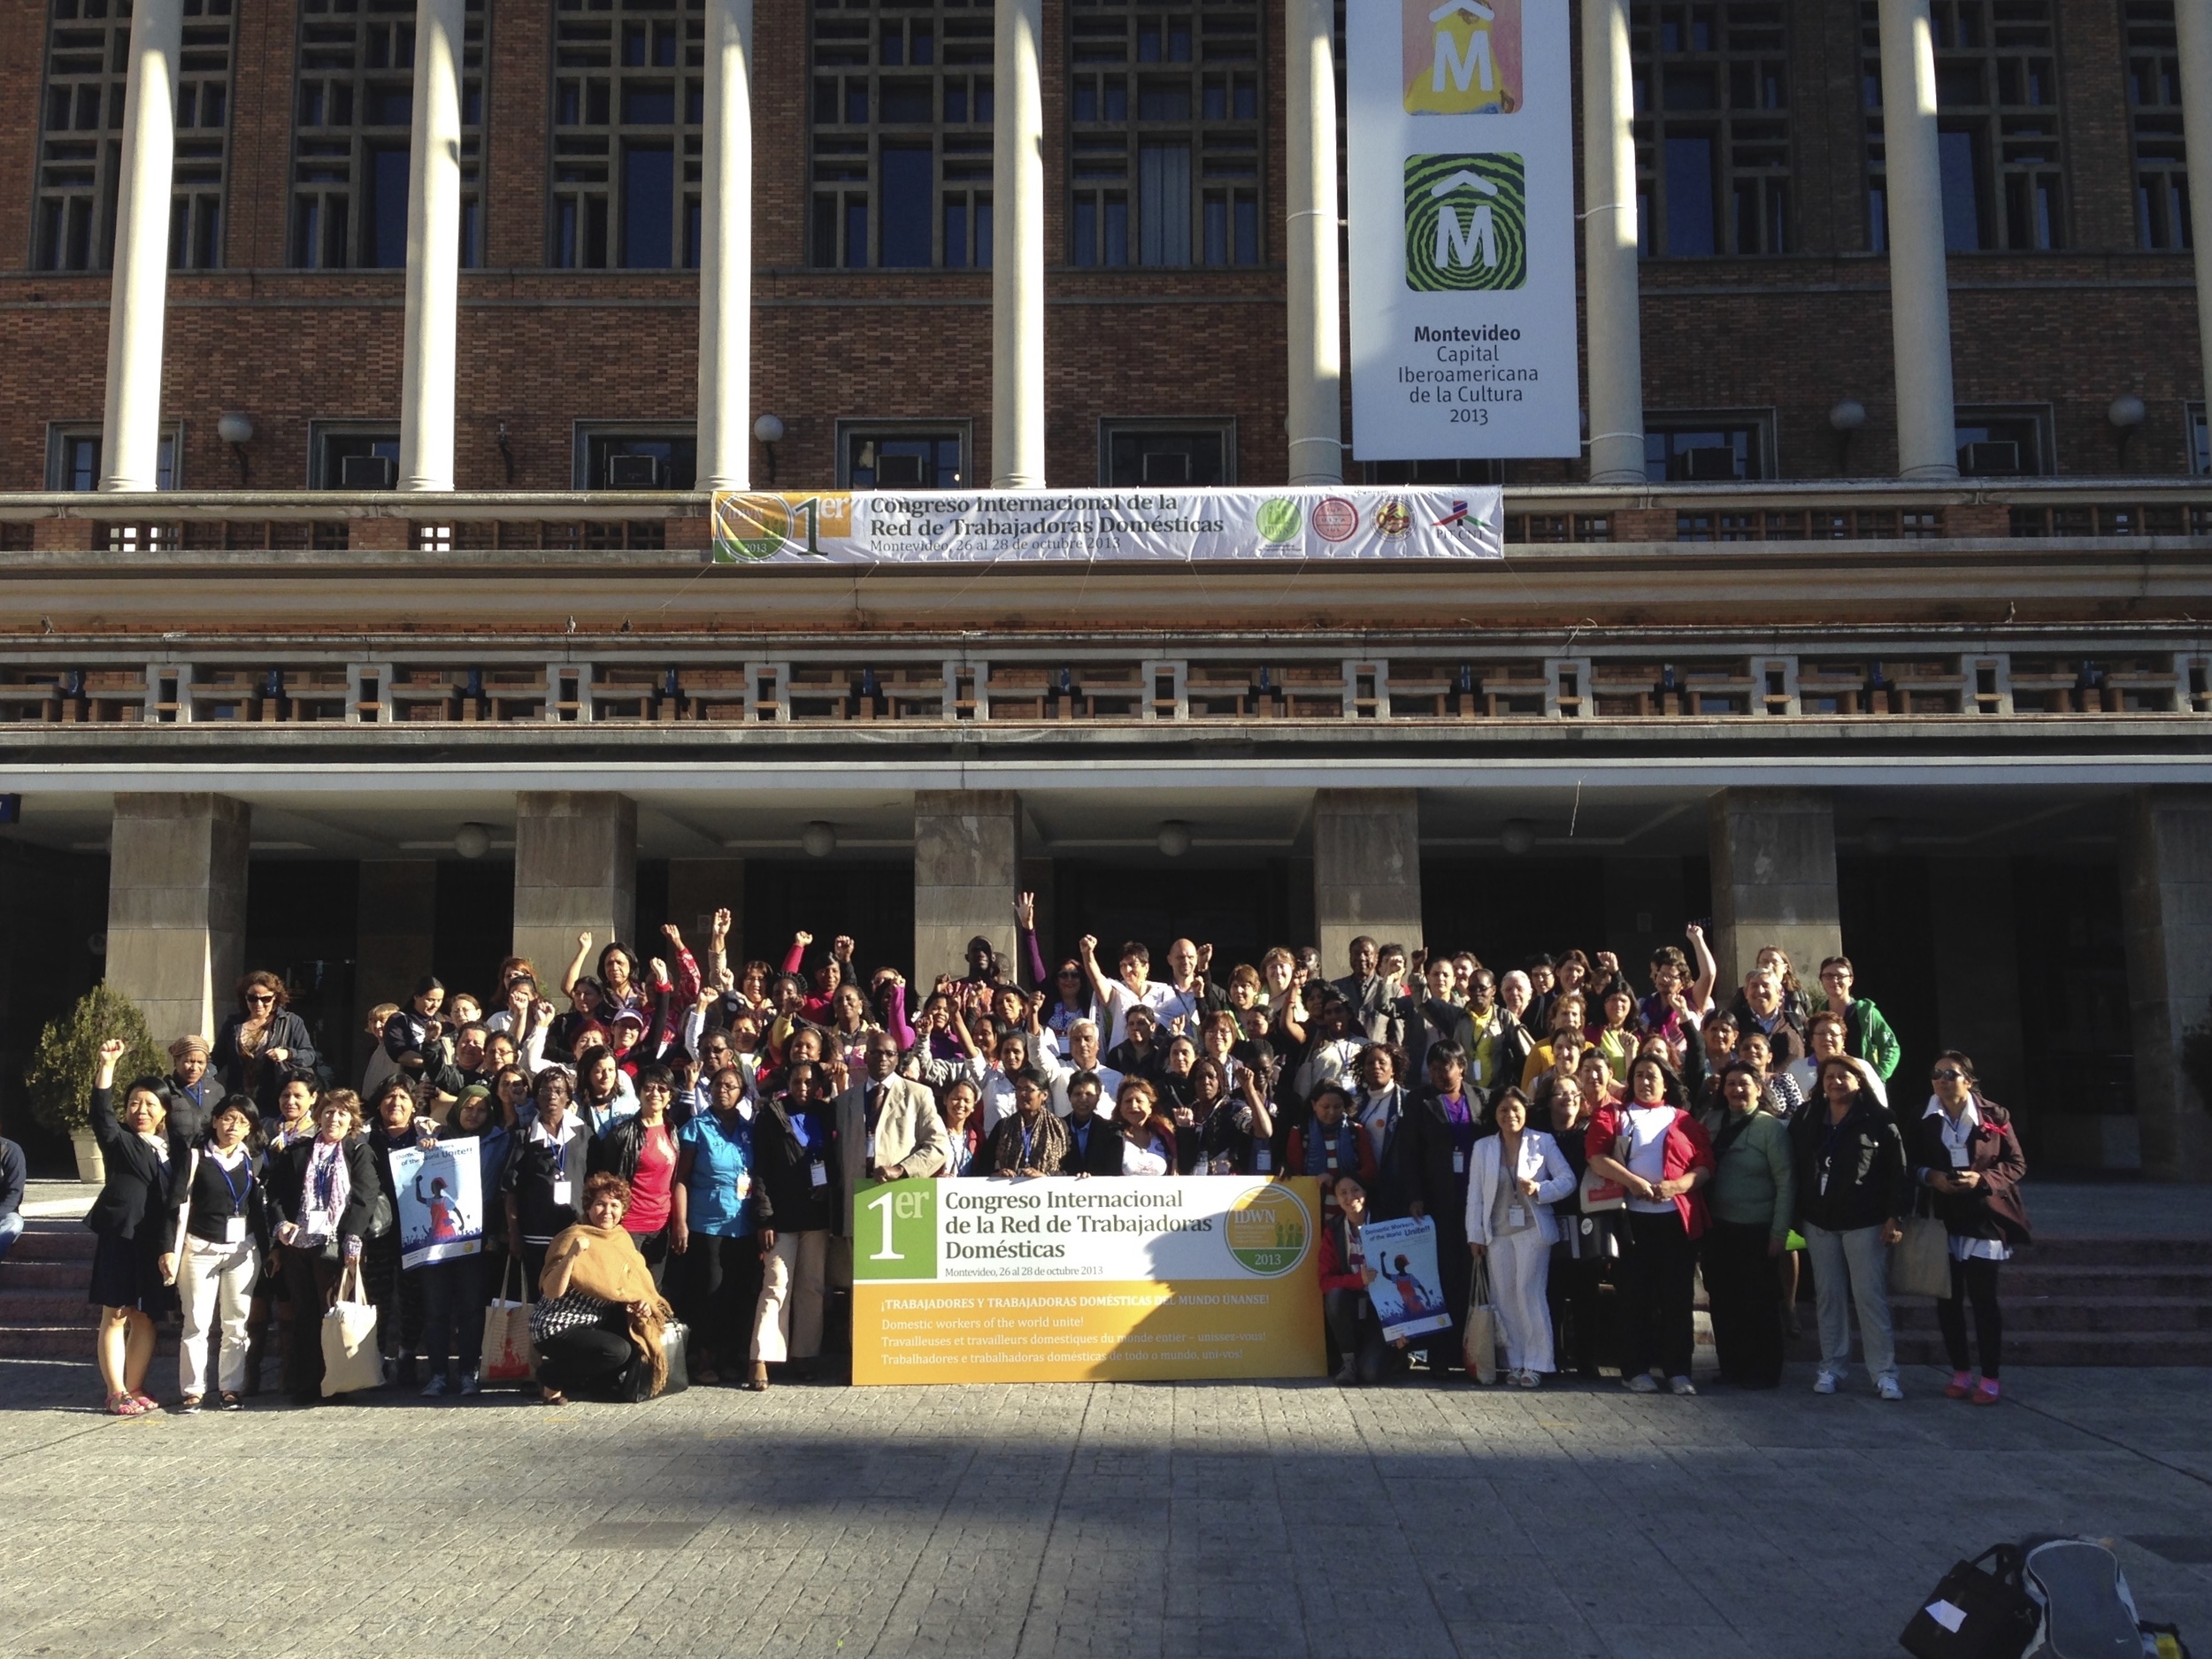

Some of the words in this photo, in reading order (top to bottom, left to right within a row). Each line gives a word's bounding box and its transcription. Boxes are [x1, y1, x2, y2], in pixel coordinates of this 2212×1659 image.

[1414, 324, 1521, 342] Montevideo
[1437, 344, 1500, 365] Capital
[1399, 365, 1539, 382] Iberoamericana
[1409, 386, 1431, 403] de
[1437, 386, 1452, 402] la
[1458, 385, 1523, 402] Cultura
[1449, 409, 1489, 426] 2013
[871, 496, 971, 518] Congreso
[976, 494, 1120, 512] Internacional
[1126, 494, 1153, 511] de
[1159, 494, 1178, 510] la
[871, 518, 911, 536] Red
[918, 518, 944, 536] de
[950, 517, 1094, 539] Trabajadoras
[1099, 516, 1225, 533] Domésticas
[744, 542, 767, 553] 2013
[871, 540, 952, 553] Montevideo,
[956, 539, 972, 550] 26
[976, 539, 987, 550] al
[992, 538, 1009, 550] 28
[1011, 538, 1028, 549] de
[1032, 537, 1083, 549] octubre
[1087, 537, 1121, 549] 2013
[945, 1192, 1041, 1214] Congreso
[1047, 1190, 1183, 1208] Internacional
[1233, 1209, 1276, 1224] IDWN
[945, 1216, 972, 1234] de
[977, 1216, 995, 1233] la
[1001, 1215, 1041, 1233] Red
[1046, 1215, 1072, 1233] de
[1077, 1214, 1212, 1237] Trabajadoras
[945, 1240, 1065, 1259] Domésticas
[1255, 1254, 1281, 1265] 2013
[945, 1266, 999, 1278] Montevideo,
[999, 1267, 1011, 1277] 26
[1012, 1266, 1020, 1276] al
[1021, 1266, 1033, 1276] 28
[1033, 1266, 1045, 1276] de
[1046, 1266, 1079, 1276] octubre
[1080, 1265, 1103, 1276] 2013
[881, 1298, 974, 1311] ¡TRABAJADORES
[976, 1298, 985, 1308] Y
[987, 1296, 1077, 1310] TRABAJADORAS
[1079, 1294, 1151, 1307] DOMÉSTICAS
[1154, 1295, 1176, 1306] DEL
[1179, 1294, 1220, 1305] MUNDO
[1222, 1293, 1270, 1305] ÚNANSE!
[881, 1318, 933, 1330] Domestic
[935, 1317, 981, 1329] workers
[984, 1317, 996, 1328] of
[997, 1317, 1015, 1328] the
[1018, 1317, 1049, 1328] world
[1052, 1316, 1084, 1327] unite!
[881, 1335, 952, 1347] Travailleuses
[954, 1336, 964, 1346] et
[967, 1334, 1028, 1346] travailleurs
[1030, 1333, 1098, 1348] domestiques
[1101, 1333, 1114, 1343] du
[1117, 1332, 1153, 1343] monde
[1156, 1332, 1187, 1342] entier
[1197, 1331, 1266, 1342] unissez-vous!
[881, 1353, 958, 1364] Trabalhadores
[970, 1352, 1045, 1363] trabalhadoras
[1048, 1350, 1107, 1363] domésticas
[1109, 1349, 1122, 1361] de
[1125, 1349, 1149, 1361] todo
[1161, 1349, 1200, 1362] mundo,
[1202, 1349, 1243, 1360] uni-vos!
